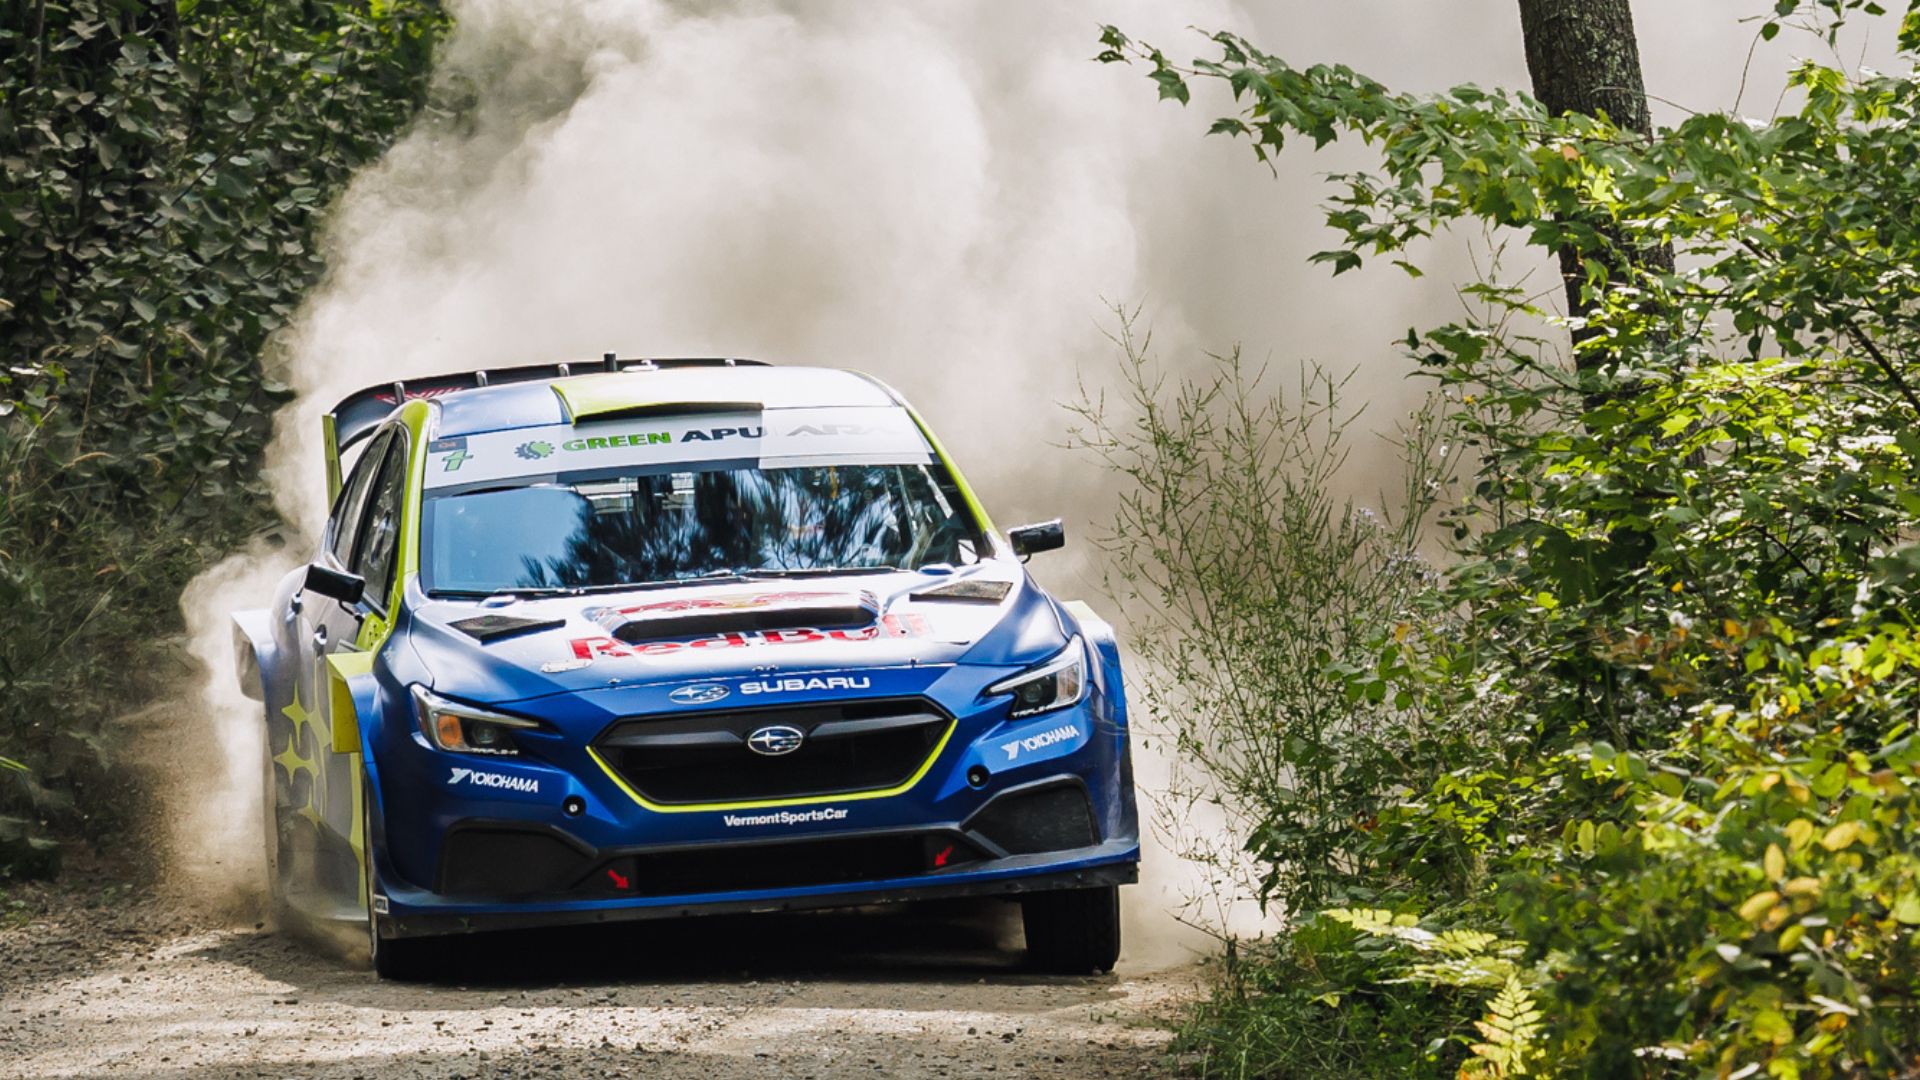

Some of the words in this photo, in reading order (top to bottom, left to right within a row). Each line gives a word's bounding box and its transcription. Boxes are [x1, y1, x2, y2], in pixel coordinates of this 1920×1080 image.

[562, 432, 672, 451] GREEN
[681, 427, 767, 443] APU
[570, 632, 746, 660] Red
[740, 677, 870, 694] SUBARU
[1020, 725, 1080, 752] YOKOHAMA
[470, 771, 539, 793] YOKOHAMA
[723, 808, 848, 828] VermontSportsCar
